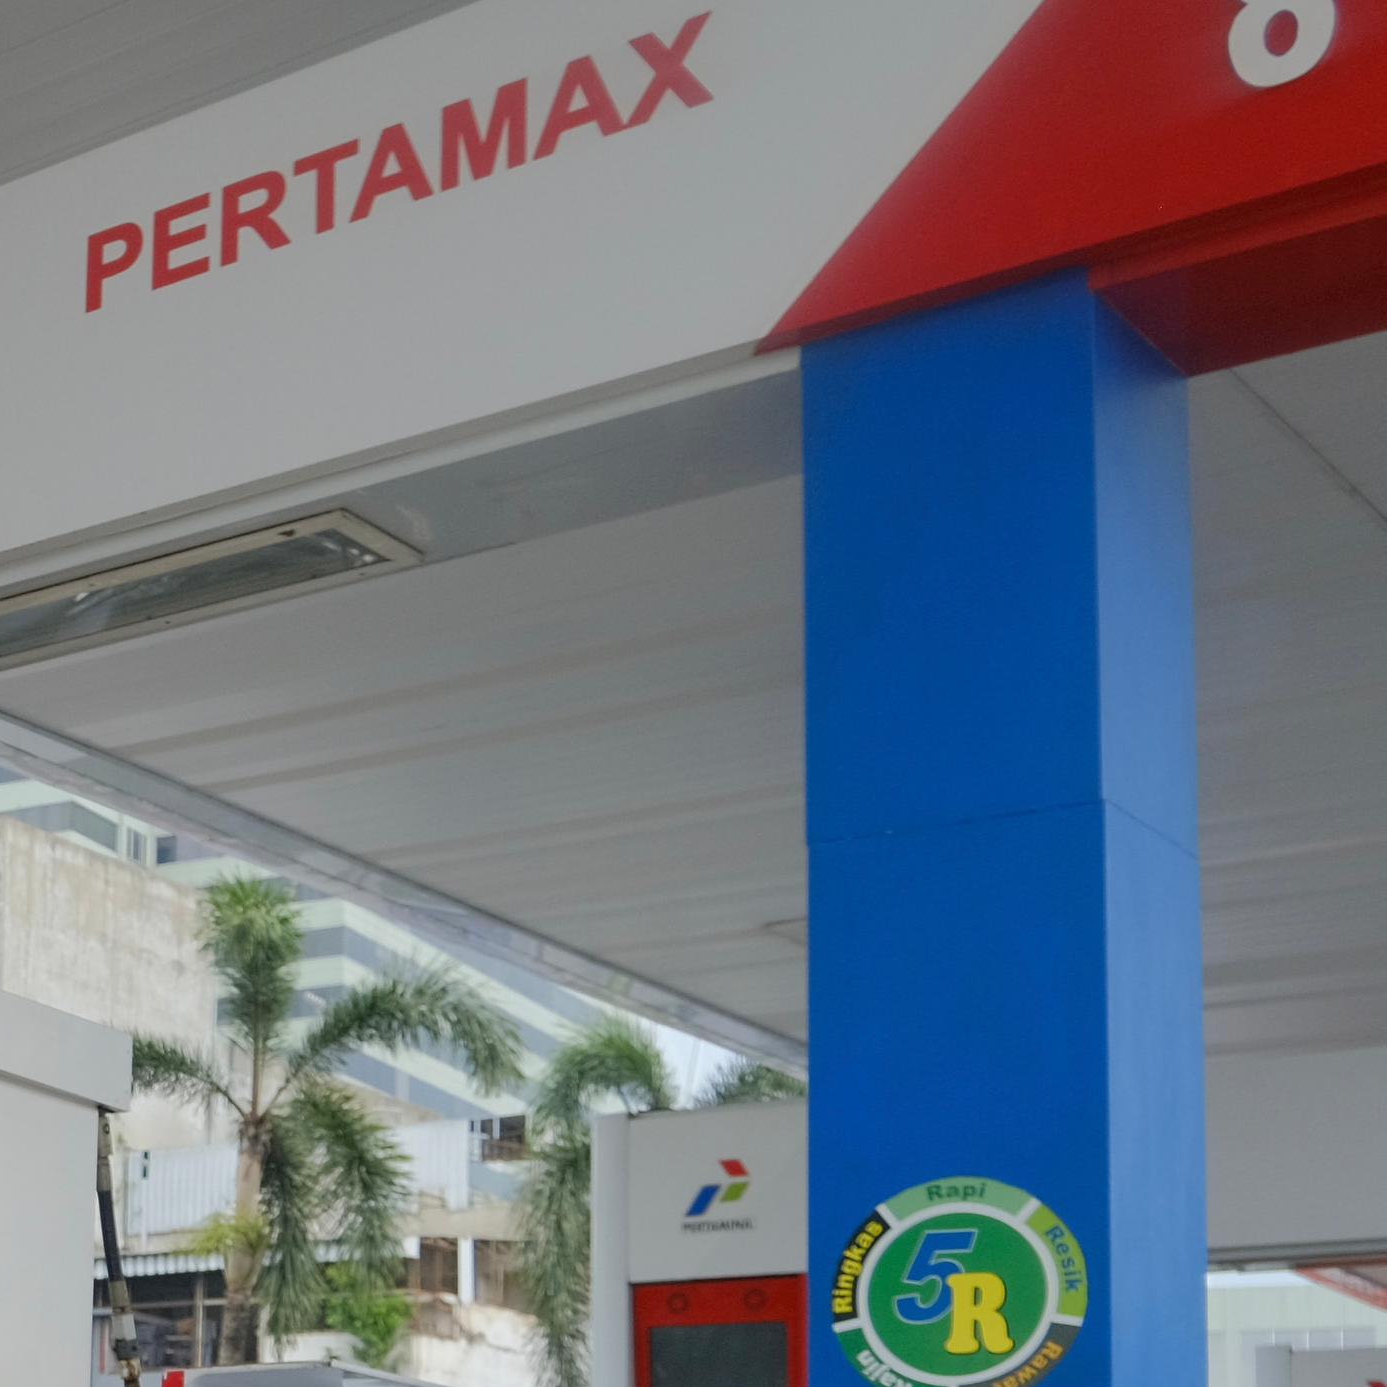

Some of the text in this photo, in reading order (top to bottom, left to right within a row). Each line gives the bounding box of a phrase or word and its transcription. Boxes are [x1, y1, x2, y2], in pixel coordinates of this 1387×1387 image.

[84, 11, 714, 313] PERTAMAX
[927, 1183, 987, 1201] Rapi
[834, 1220, 884, 1314] Ringkas
[1046, 1225, 1083, 1292] Resik
